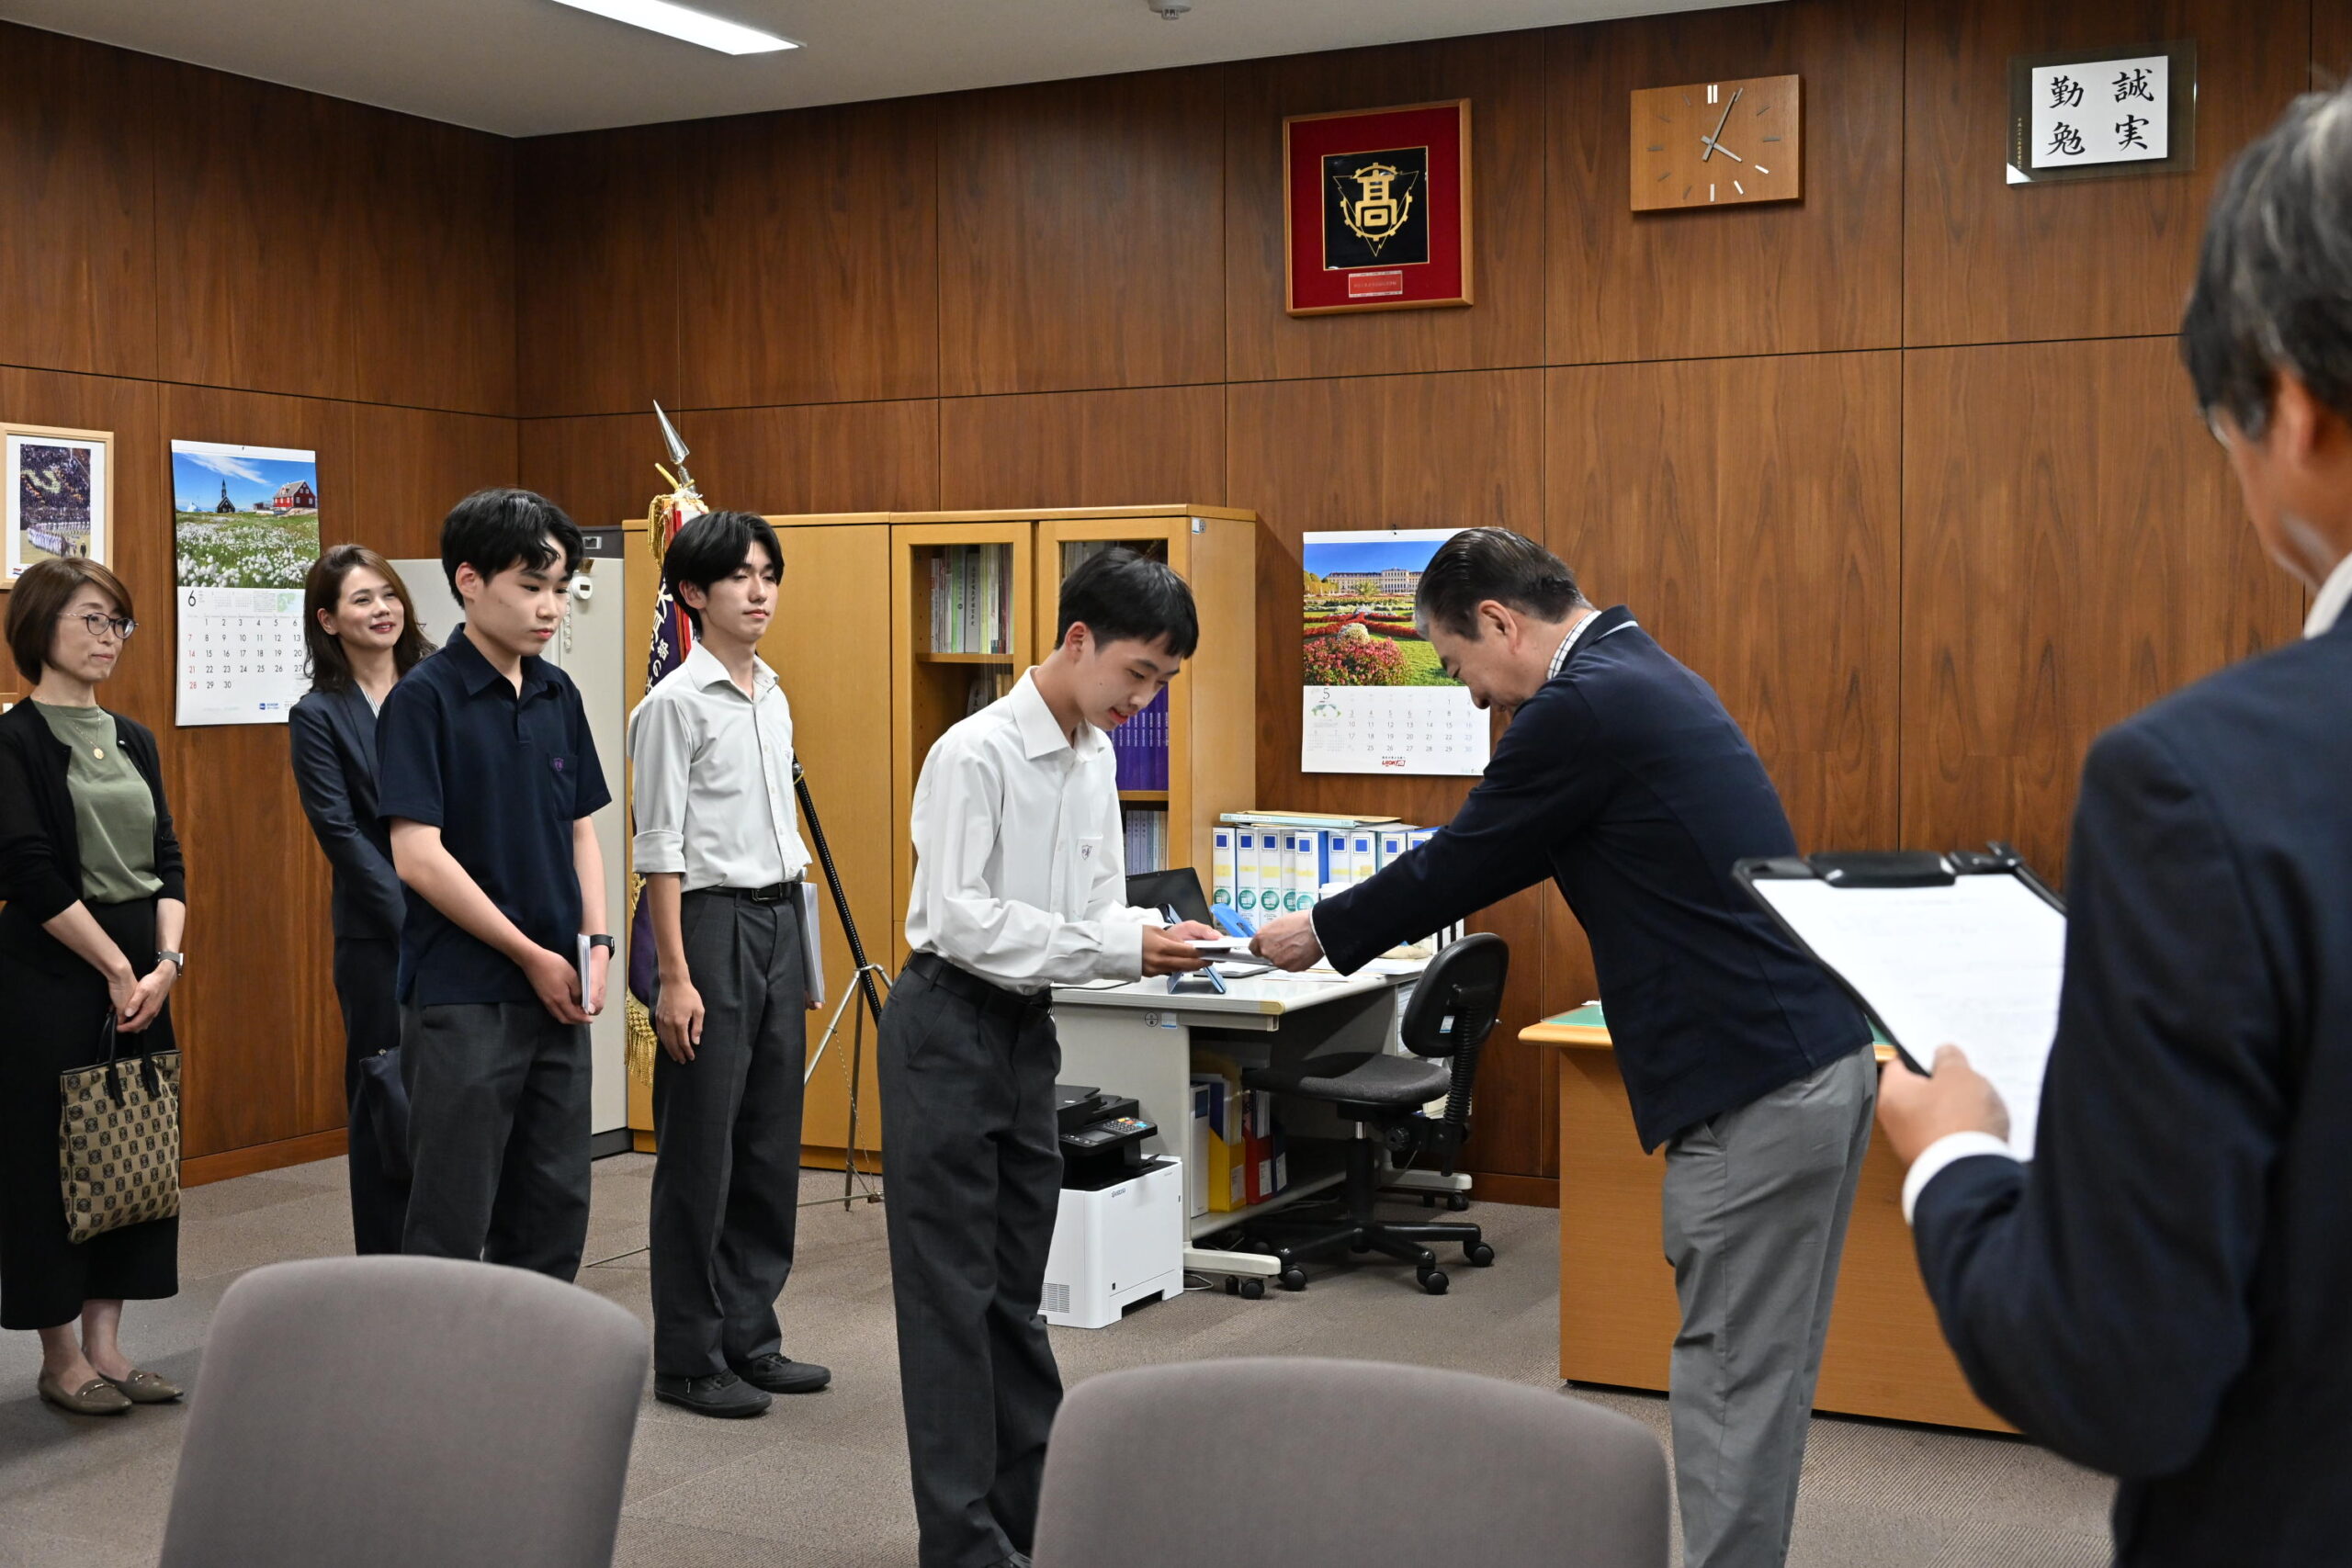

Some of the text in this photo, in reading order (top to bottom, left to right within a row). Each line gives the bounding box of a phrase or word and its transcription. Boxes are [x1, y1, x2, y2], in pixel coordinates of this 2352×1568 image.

[2111, 68, 2154, 152] 誠実
[2046, 75, 2086, 156] 勤勉
[188, 590, 197, 607] 6
[240, 634, 246, 642] 10
[275, 634, 281, 642] 12
[294, 634, 300, 642] 13
[207, 649, 213, 658] 15
[224, 649, 231, 658] 16
[241, 649, 247, 658] 17
[257, 649, 264, 658] 18
[276, 649, 282, 658] 19
[294, 649, 302, 658] 20
[189, 665, 302, 673] 21 22 23 24 25 26 27
[207, 681, 214, 689] 29
[224, 681, 232, 689] 30
[1323, 688, 1330, 700] 5
